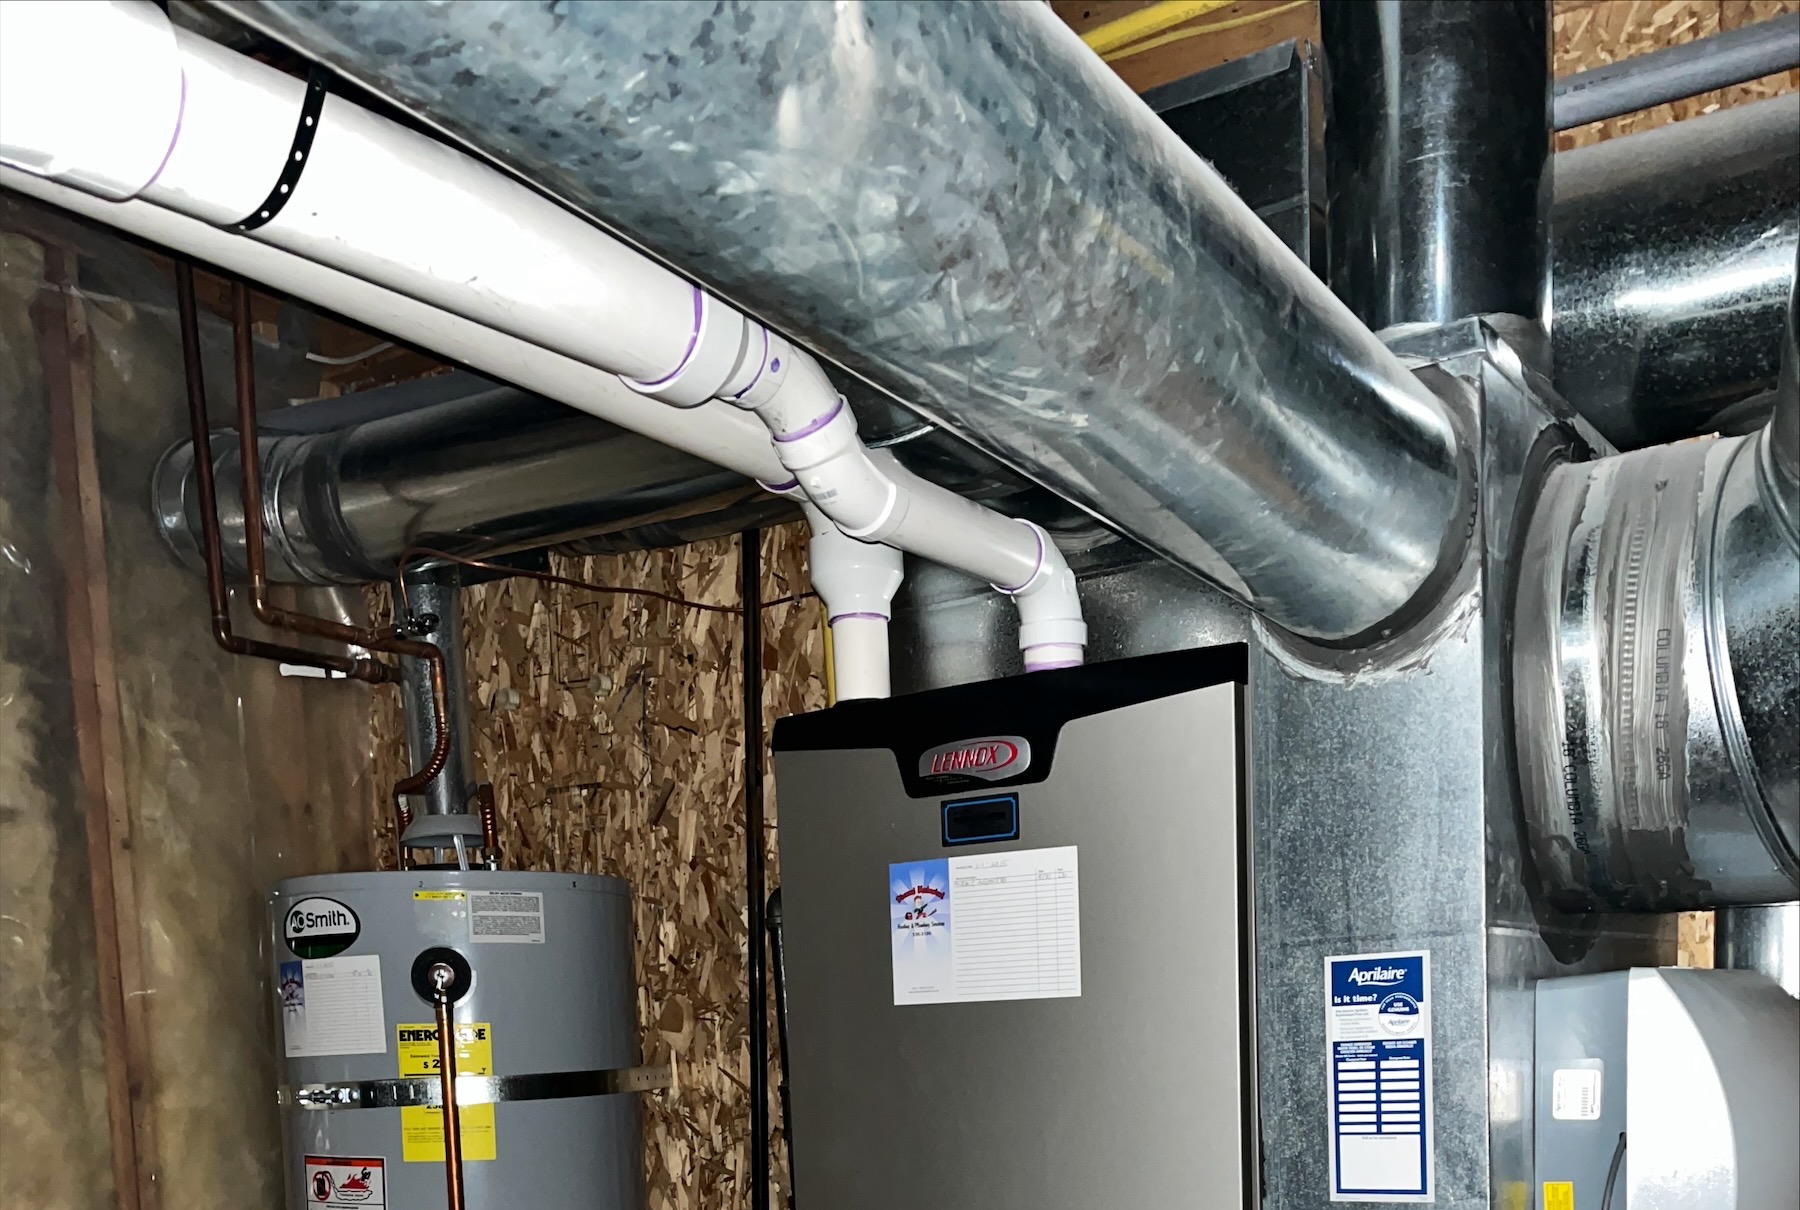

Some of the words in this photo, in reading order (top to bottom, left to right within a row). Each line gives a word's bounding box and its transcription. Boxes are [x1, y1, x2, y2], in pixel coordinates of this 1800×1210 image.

[1655, 629, 1671, 703] COLUMBIA
[931, 745, 1000, 774] LENNOX
[1563, 765, 1583, 825] COLUMBIA
[1348, 966, 1406, 986] Aprilaire
[1334, 995, 1342, 1004] Is
[1343, 994, 1351, 1003] it
[1352, 993, 1378, 1002] time?
